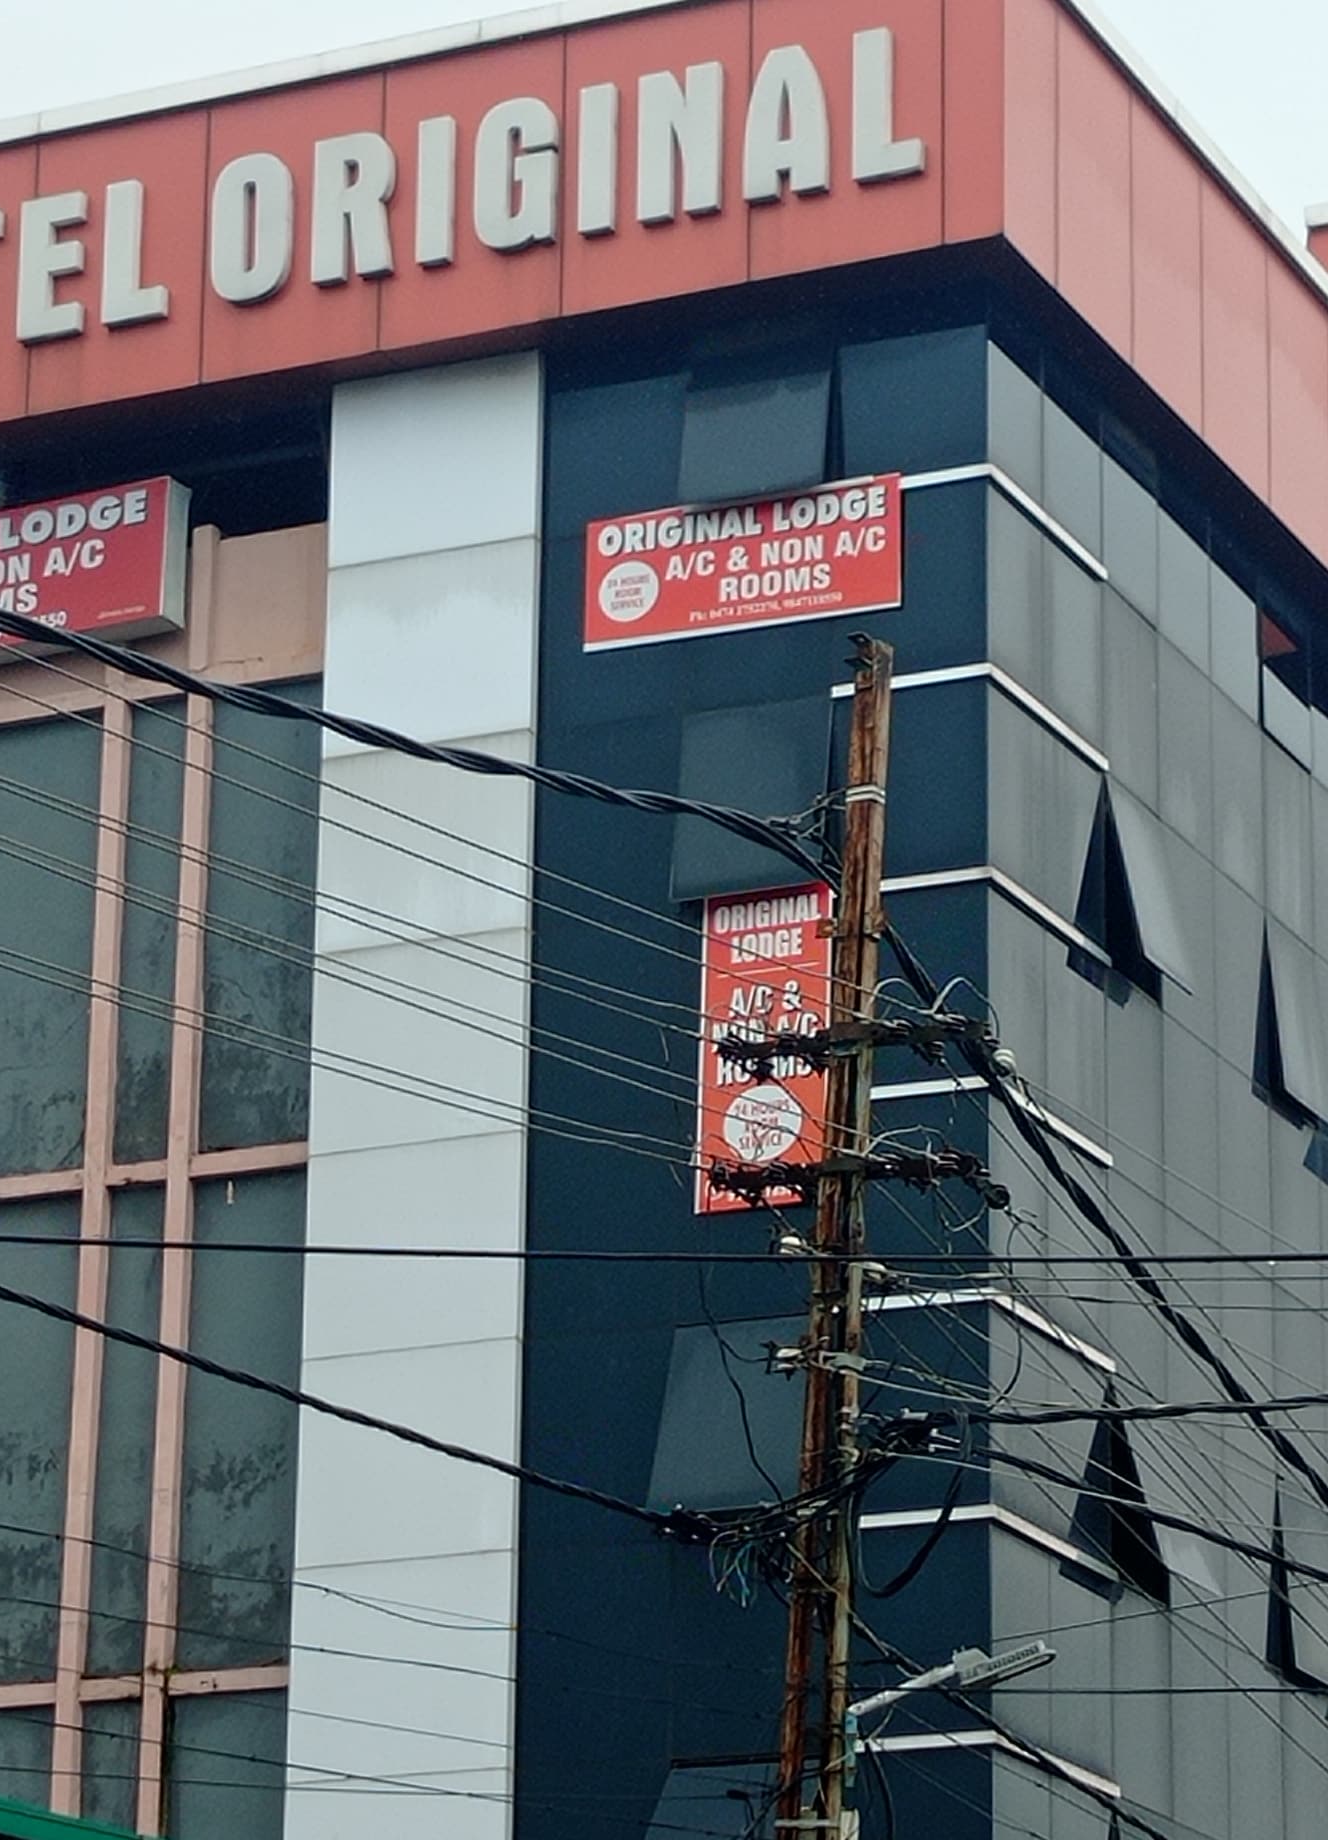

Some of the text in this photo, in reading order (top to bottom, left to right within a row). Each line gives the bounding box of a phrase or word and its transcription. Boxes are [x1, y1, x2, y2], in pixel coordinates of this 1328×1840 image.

[210, 27, 926, 306] ORIGINAL
[598, 485, 886, 556] ORIGINAL LODGE
[43, 538, 105, 578] A/C
[665, 526, 886, 581] A/C & NON A/C
[718, 563, 831, 603] ROOMS
[714, 893, 823, 934] ORIGINAL
[730, 928, 803, 964] LODGE
[728, 979, 803, 1018] A/C &
